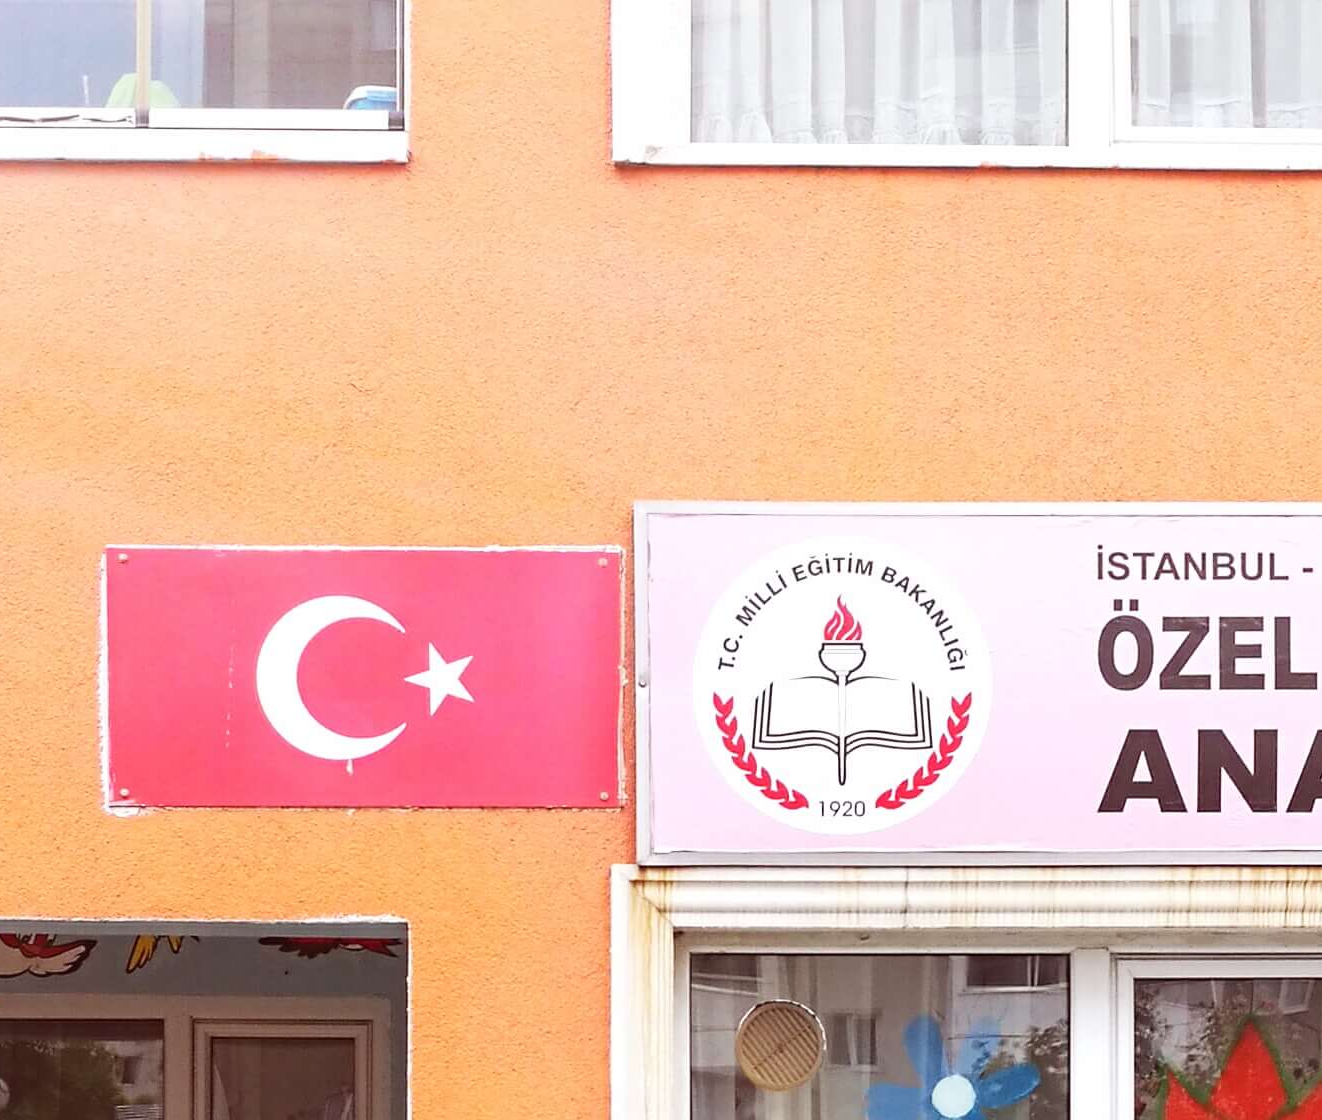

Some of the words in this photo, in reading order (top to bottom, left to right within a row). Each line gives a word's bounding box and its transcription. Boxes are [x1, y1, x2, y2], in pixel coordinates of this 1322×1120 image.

[1097, 544, 1289, 581] İSTANBUL
[717, 634, 743, 671] T.C.
[735, 570, 788, 627] MİLLİ
[791, 552, 874, 582] EĞİTİM
[880, 566, 967, 671] BAKANLIĞI
[1097, 598, 1318, 691] ÖZEL
[820, 800, 866, 817] 1920
